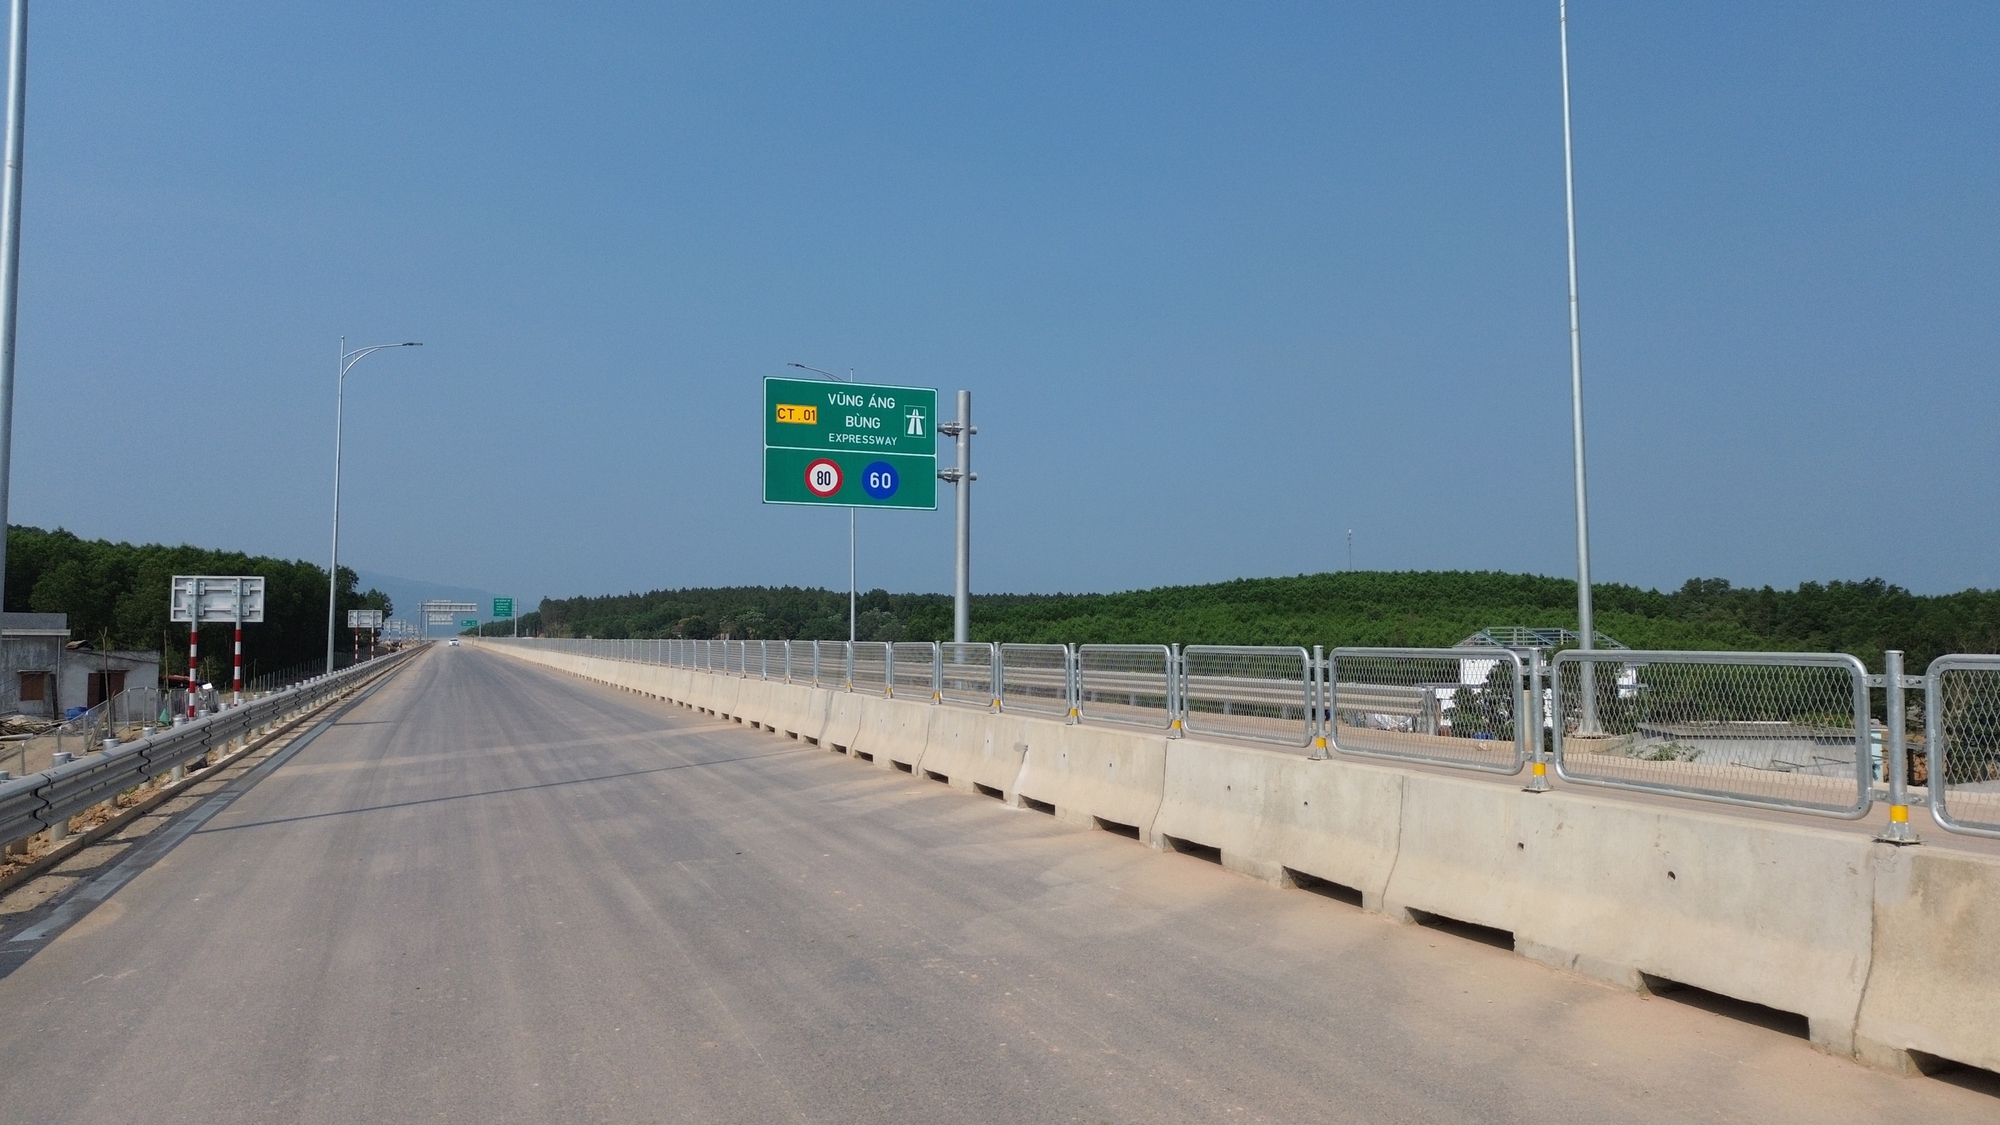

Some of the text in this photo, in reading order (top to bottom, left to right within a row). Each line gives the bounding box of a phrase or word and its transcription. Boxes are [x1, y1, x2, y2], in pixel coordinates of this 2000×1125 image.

[827, 391, 896, 409] VŨNG ÁNG
[845, 412, 881, 429] BÙNG
[828, 432, 898, 446] EXPRESSWAY
[816, 470, 831, 486] 80
[869, 472, 892, 489] 60
